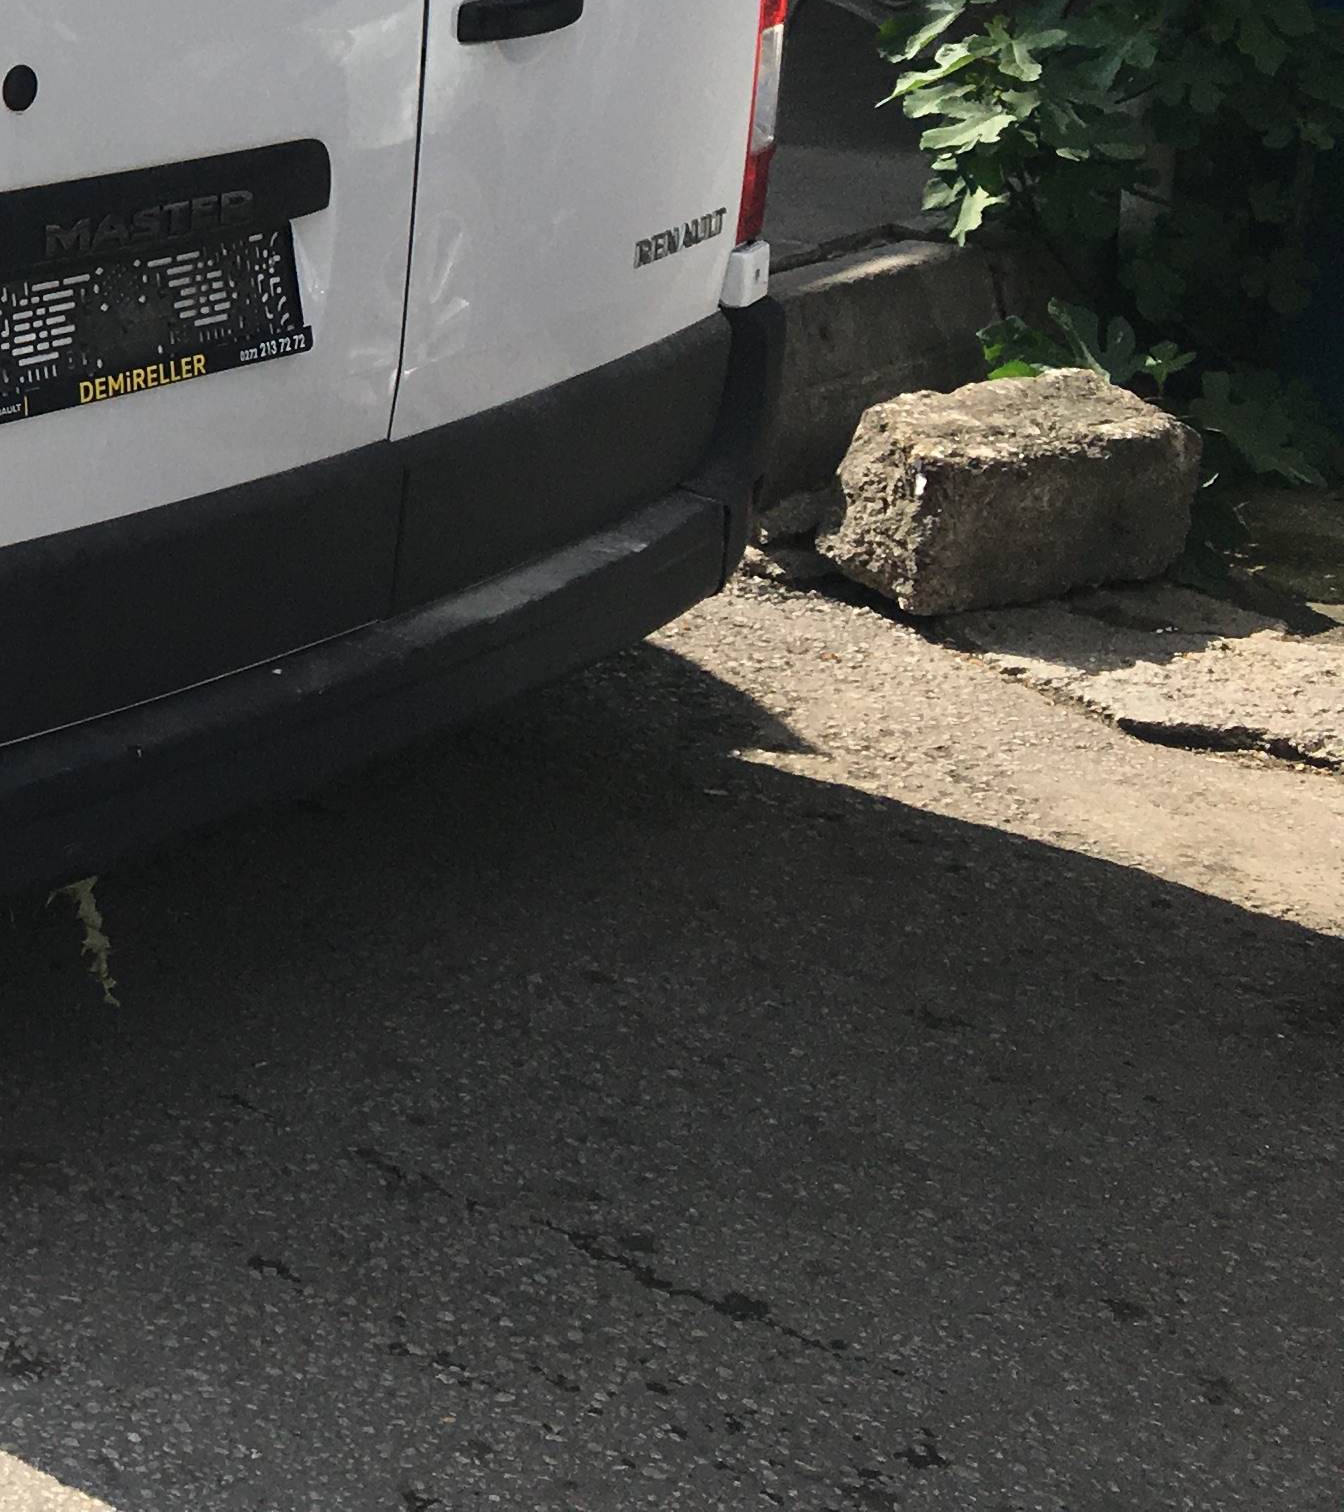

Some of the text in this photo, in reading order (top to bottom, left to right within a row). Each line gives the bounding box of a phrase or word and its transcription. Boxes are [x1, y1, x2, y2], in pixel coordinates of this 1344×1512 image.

[44, 190, 254, 258] MASTER
[633, 206, 727, 269] RENAULT
[259, 339, 278, 358] 213
[278, 336, 292, 353] 72
[293, 333, 306, 349] 72
